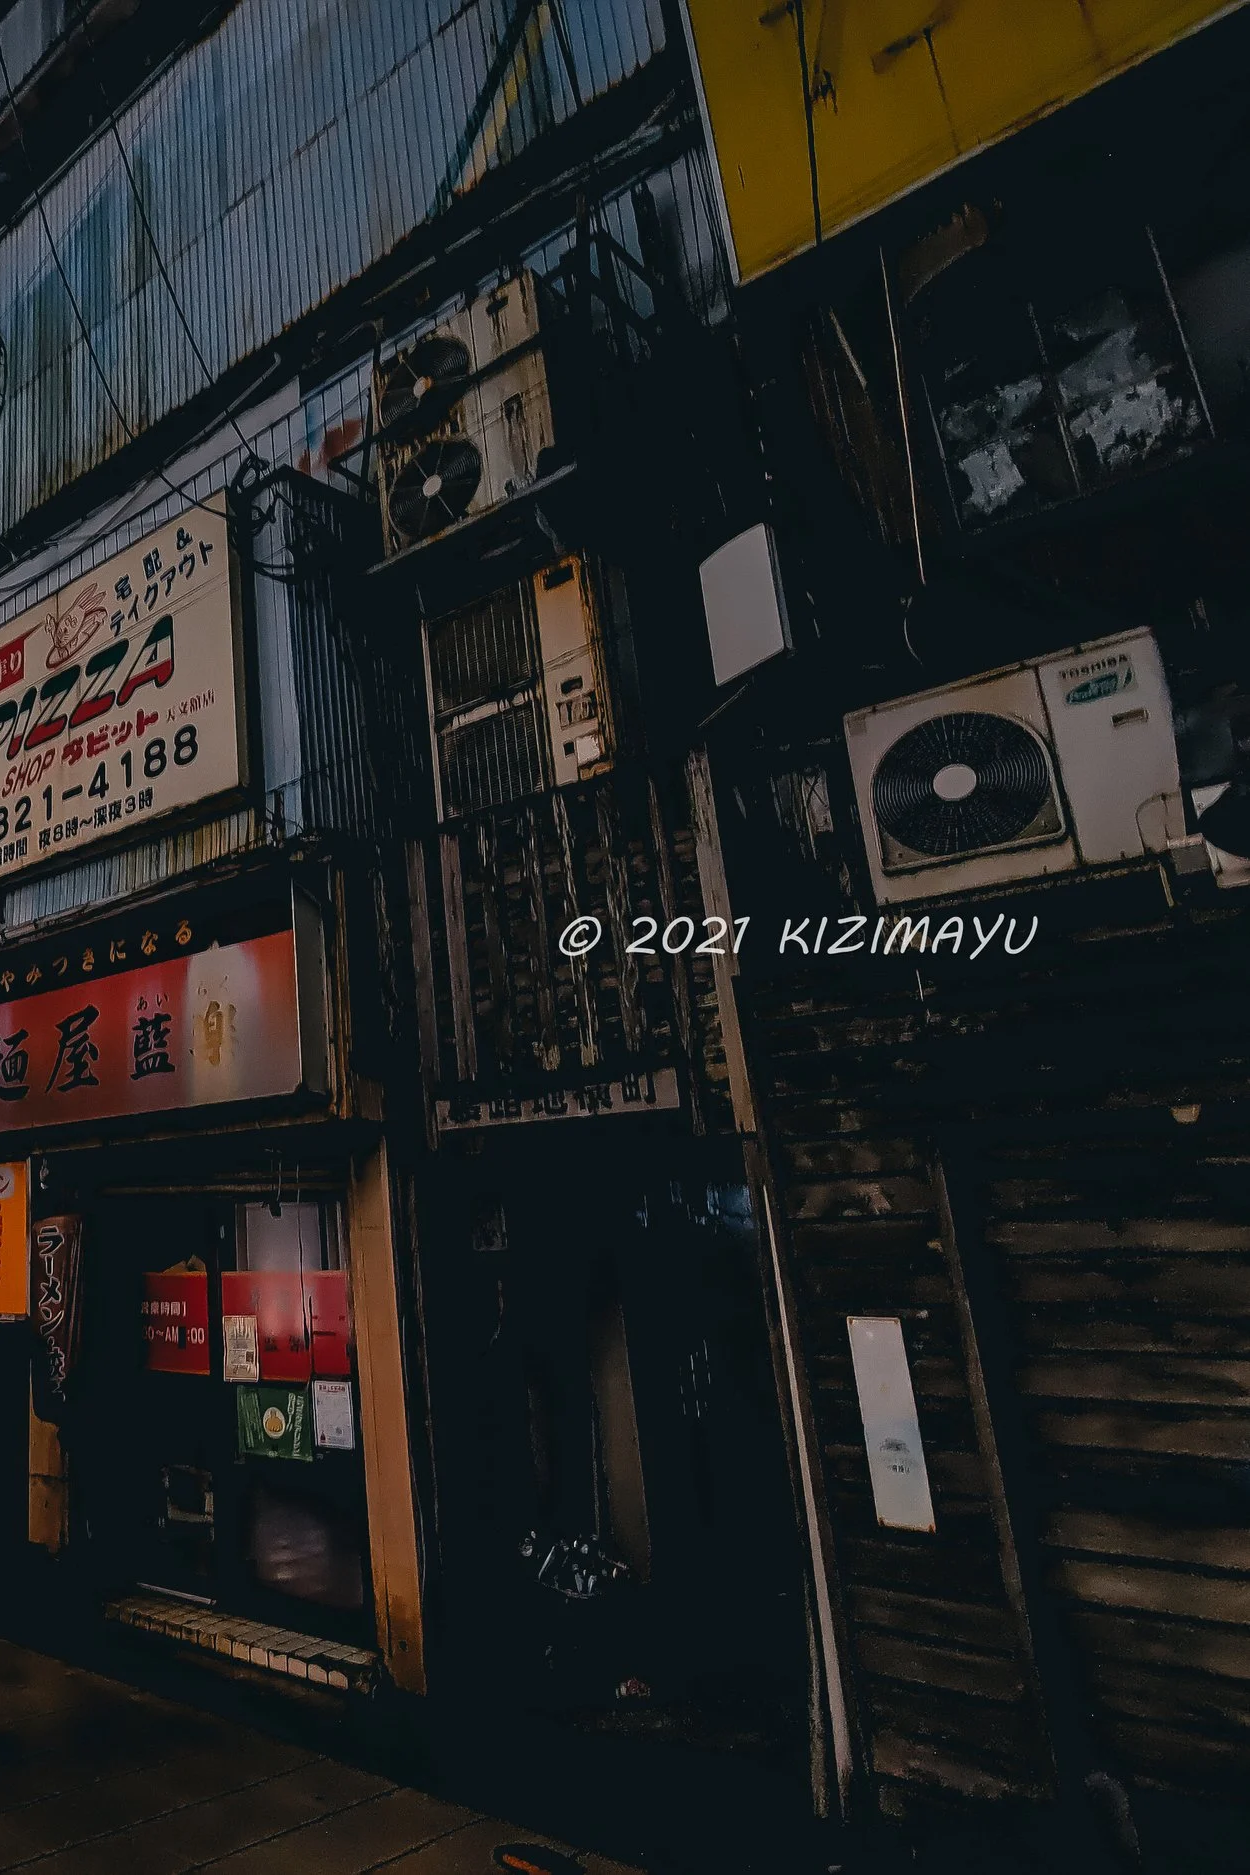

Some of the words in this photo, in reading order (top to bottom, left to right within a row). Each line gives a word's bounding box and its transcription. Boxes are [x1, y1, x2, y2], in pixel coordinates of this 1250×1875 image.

[110, 541, 215, 637] テイクアウト
[1059, 654, 1127, 680] TOSHIBA
[2, 748, 54, 798] SHOP
[37, 1225, 65, 1337] ラーメン
